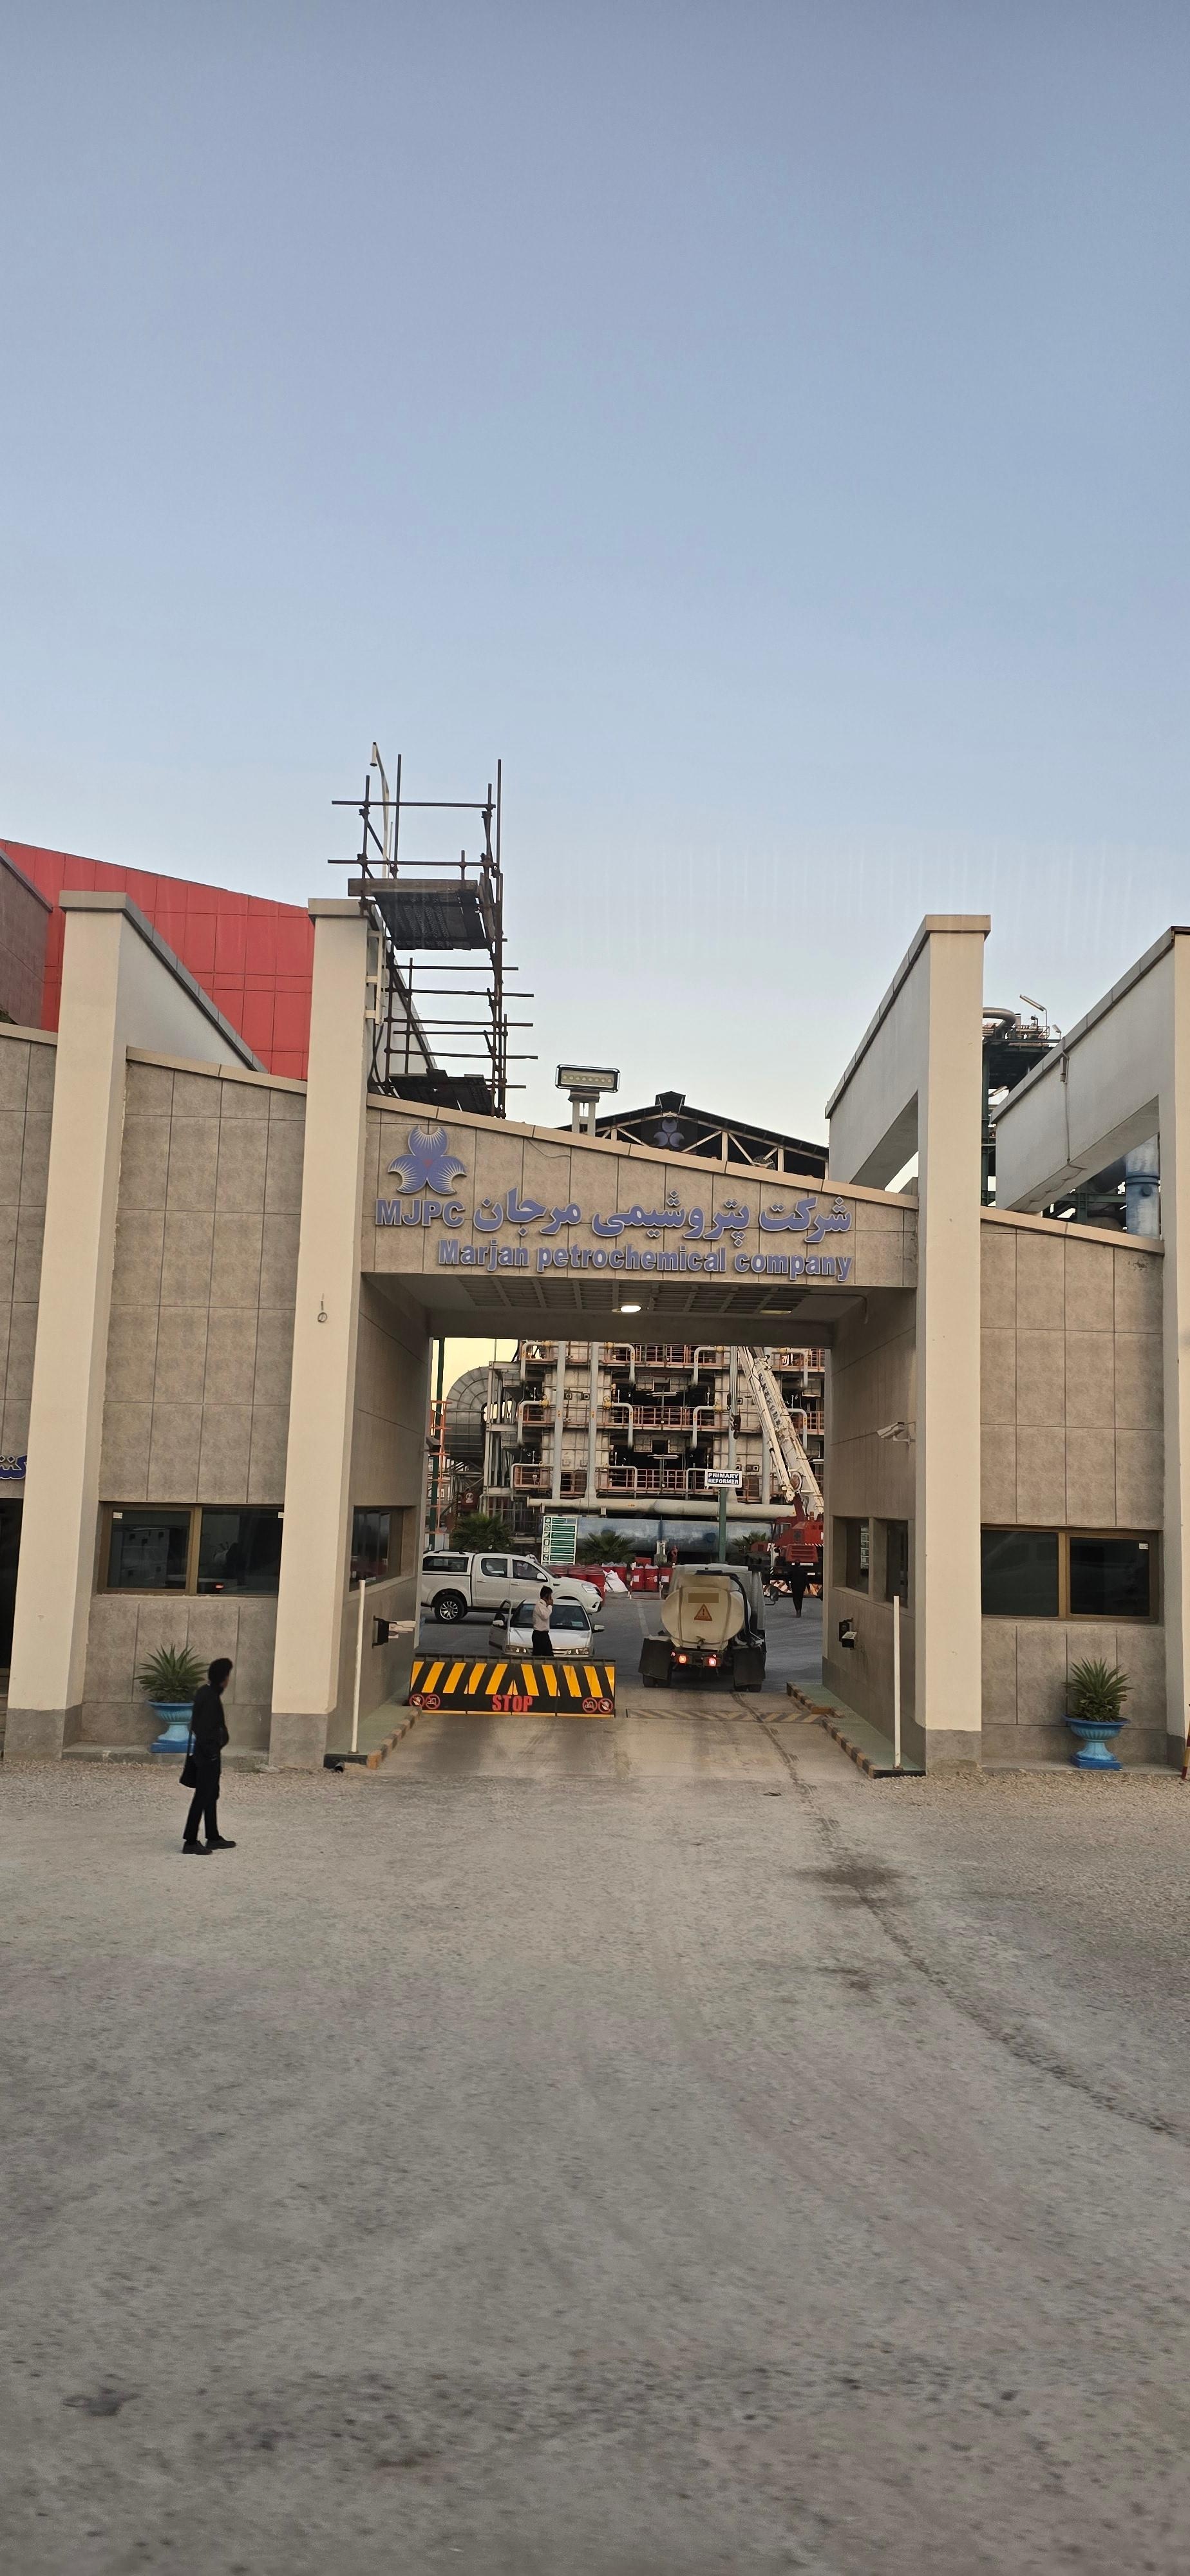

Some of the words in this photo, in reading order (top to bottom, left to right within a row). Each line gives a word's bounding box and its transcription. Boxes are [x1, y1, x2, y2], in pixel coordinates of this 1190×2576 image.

[375, 1198, 466, 1227] MJPC
[473, 1187, 582, 1236] مرجان
[592, 1189, 751, 1247] پتروشیمی
[759, 1197, 852, 1243] شرکت
[439, 1238, 529, 1271] Marjan
[537, 1244, 726, 1273] petrochemical
[735, 1251, 853, 1282] company
[492, 1694, 533, 1712] STOP
